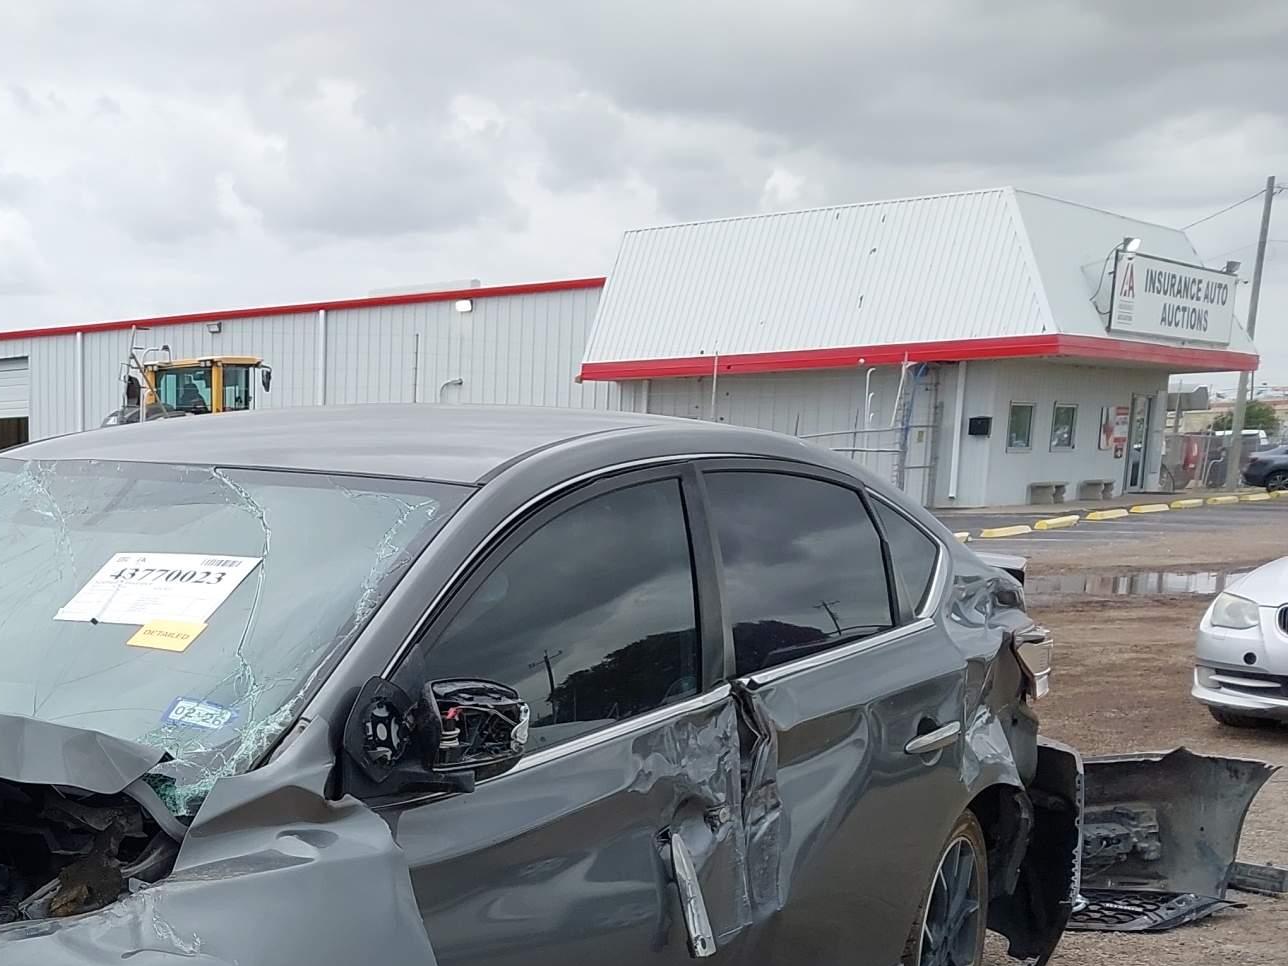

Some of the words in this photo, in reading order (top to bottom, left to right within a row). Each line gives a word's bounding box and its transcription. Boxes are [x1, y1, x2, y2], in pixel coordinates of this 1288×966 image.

[1144, 268, 1203, 301] INSURANCE
[1203, 278, 1229, 306] AUTO
[1160, 302, 1209, 332] AUCTIONS
[110, 567, 227, 584] 43770023
